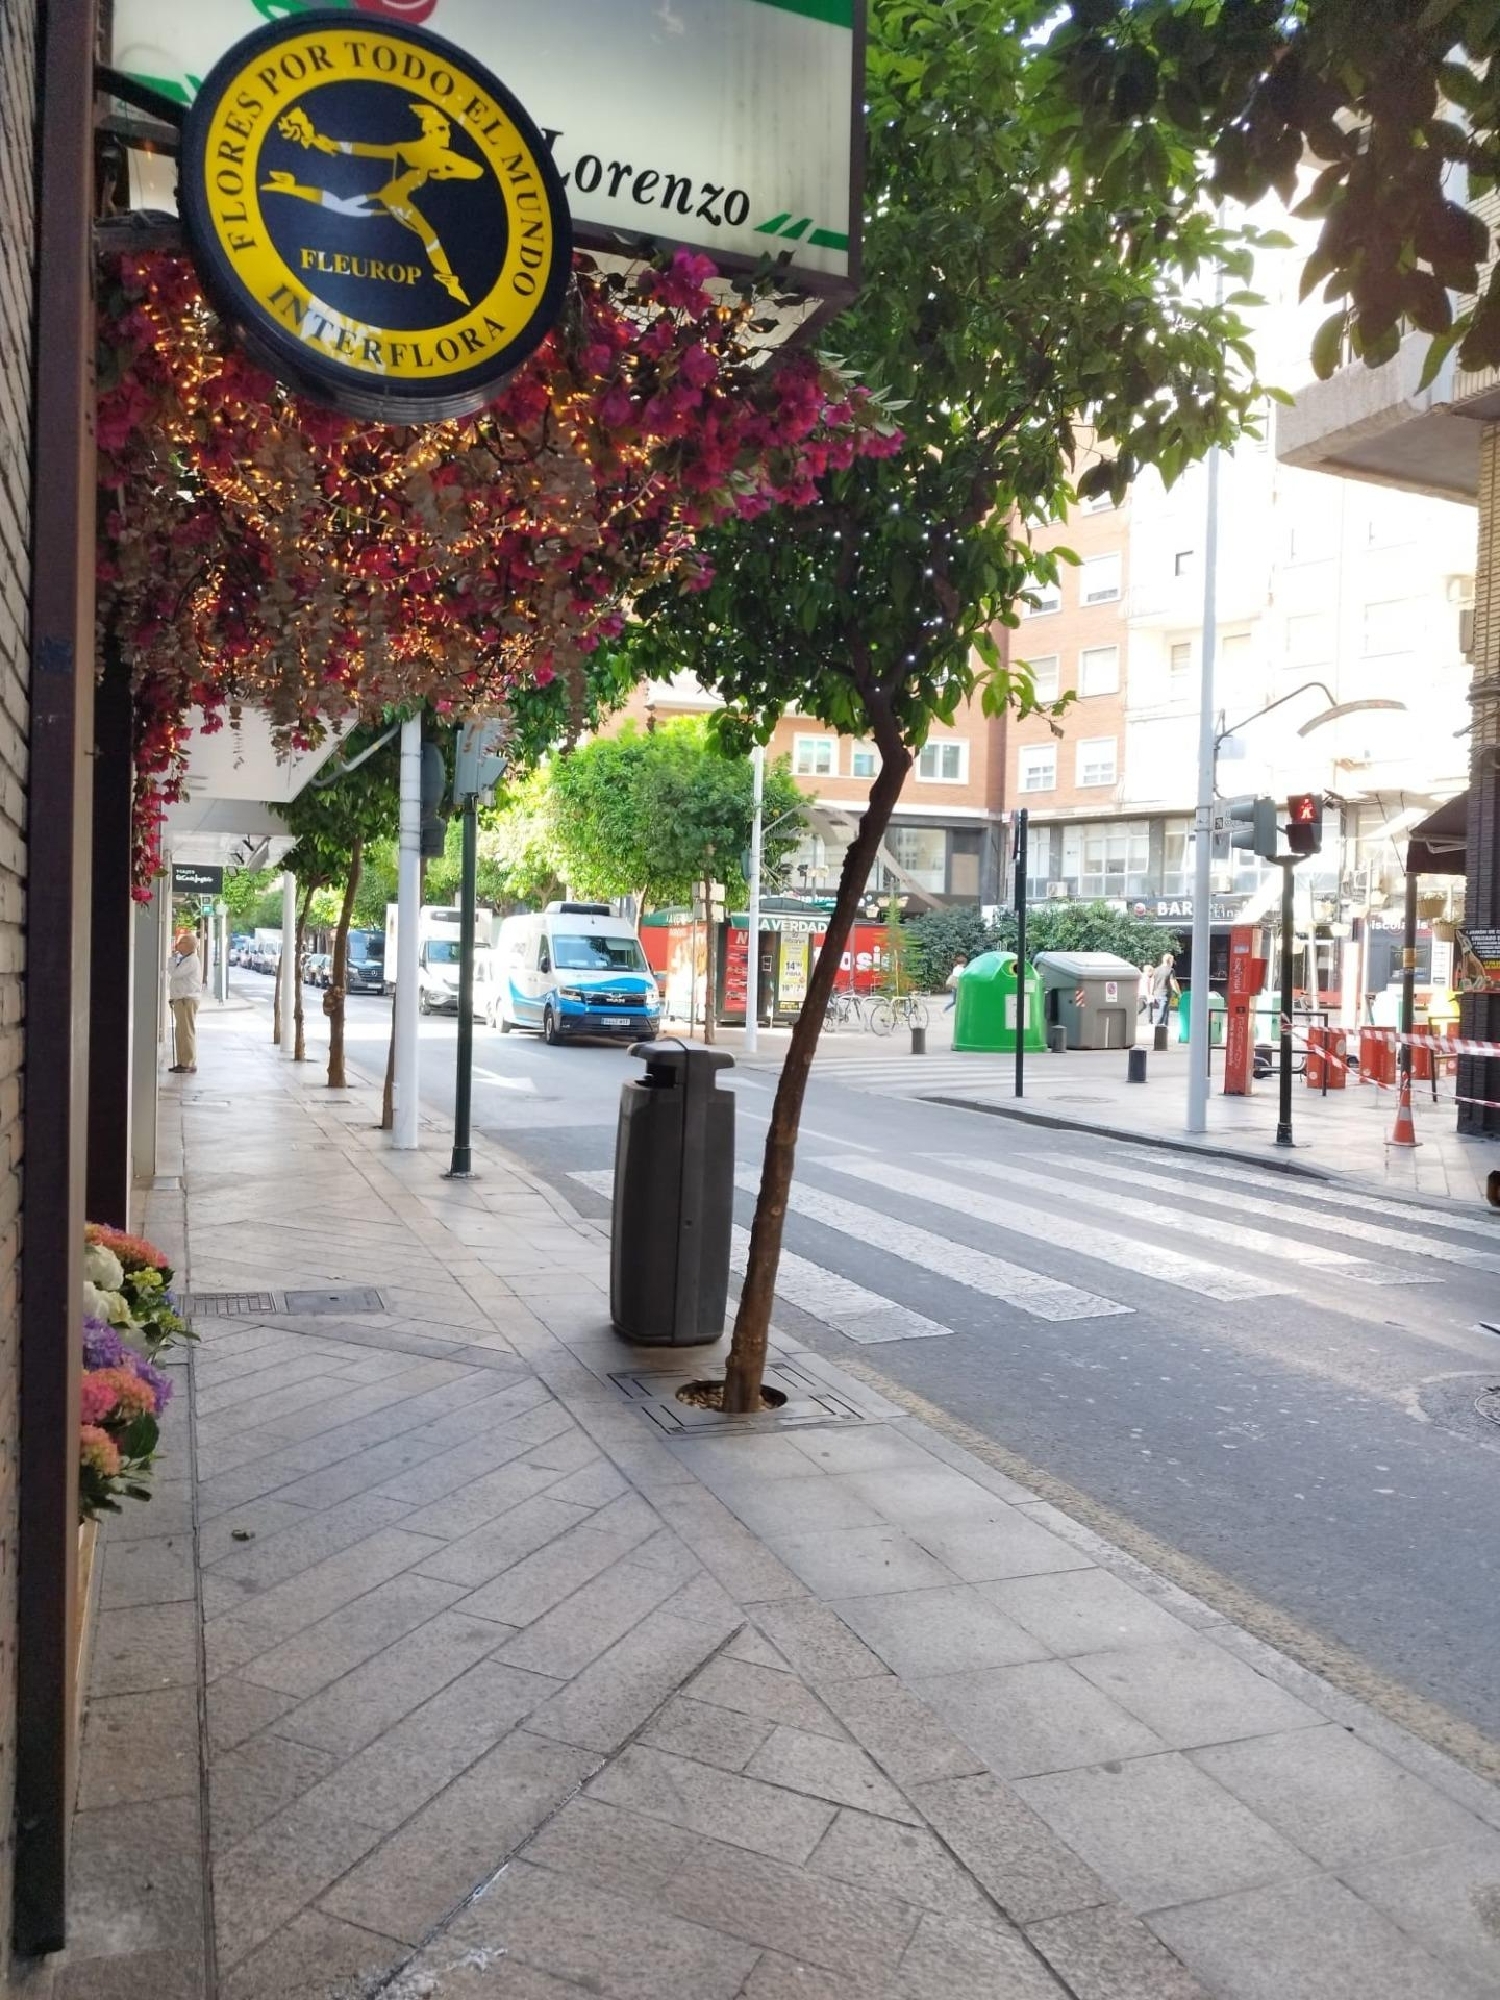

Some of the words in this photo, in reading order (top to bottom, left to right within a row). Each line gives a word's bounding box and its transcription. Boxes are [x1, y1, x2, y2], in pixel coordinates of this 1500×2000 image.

[217, 92, 264, 253] FLORES
[258, 45, 334, 96] POR
[343, 42, 455, 98] TODO
[461, 96, 503, 146] EL
[501, 154, 544, 298] MUNDO
[300, 249, 423, 286] FLEUROP
[268, 283, 507, 369] INTERFLORA
[772, 919, 828, 933] VERDAD
[1157, 901, 1193, 917] BAR
